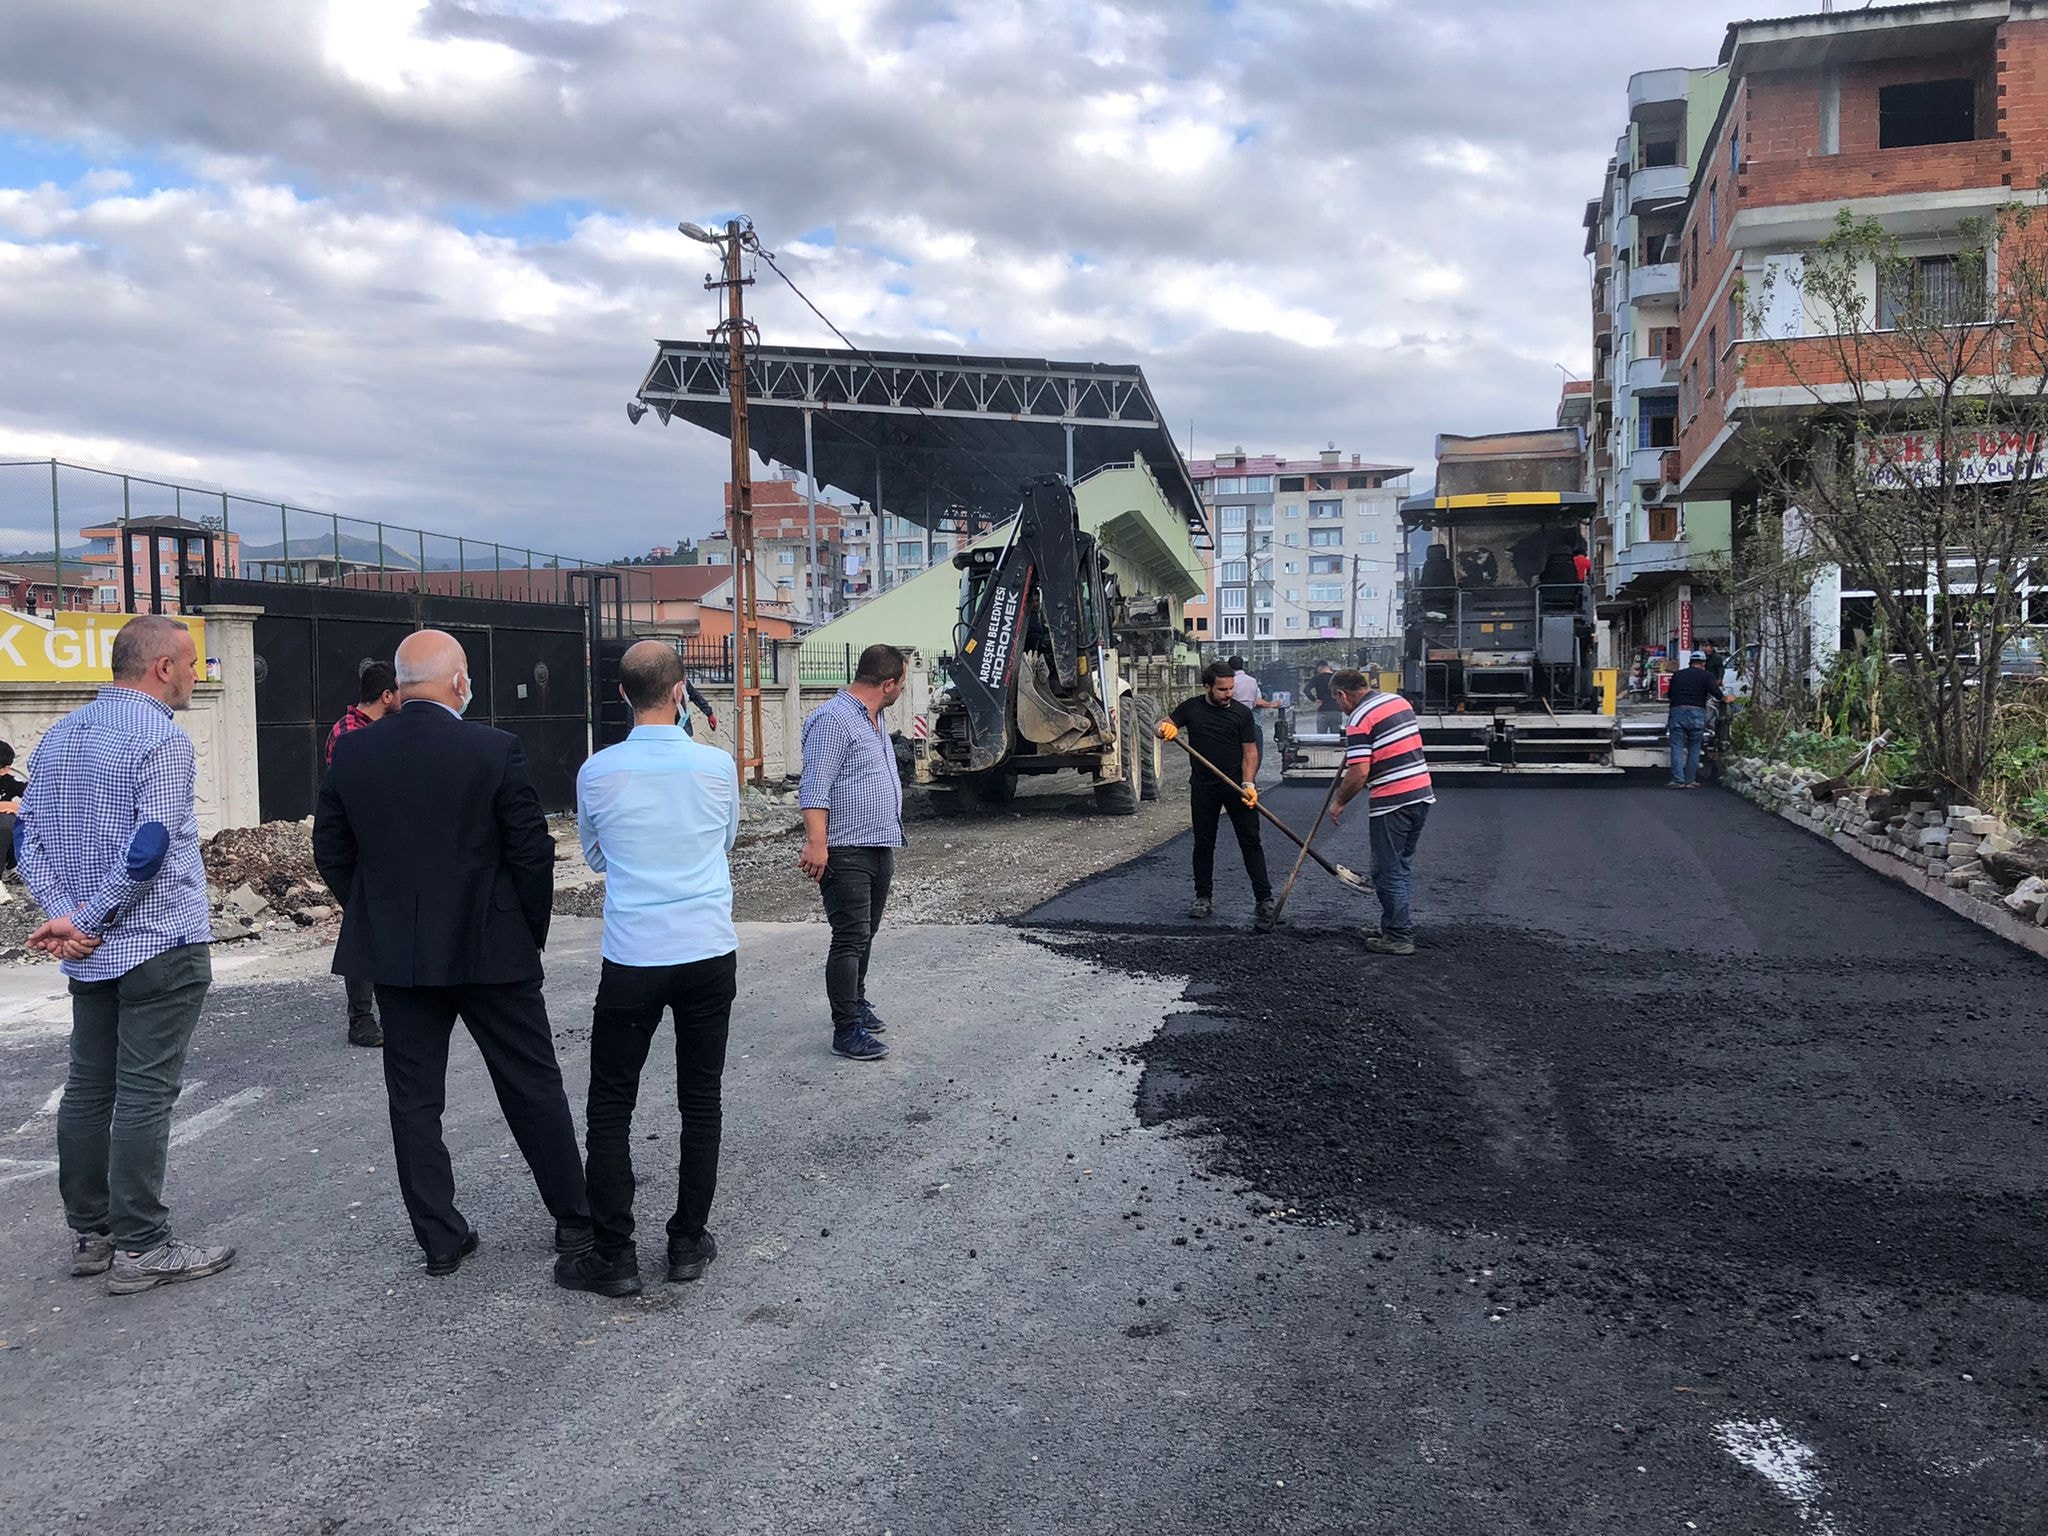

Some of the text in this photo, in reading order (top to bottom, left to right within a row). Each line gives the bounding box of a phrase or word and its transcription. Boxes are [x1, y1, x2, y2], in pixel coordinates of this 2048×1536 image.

[979, 586, 1007, 683] ARDEŞEN BELEDİYESİ
[989, 590, 1019, 689] HİDROMEK
